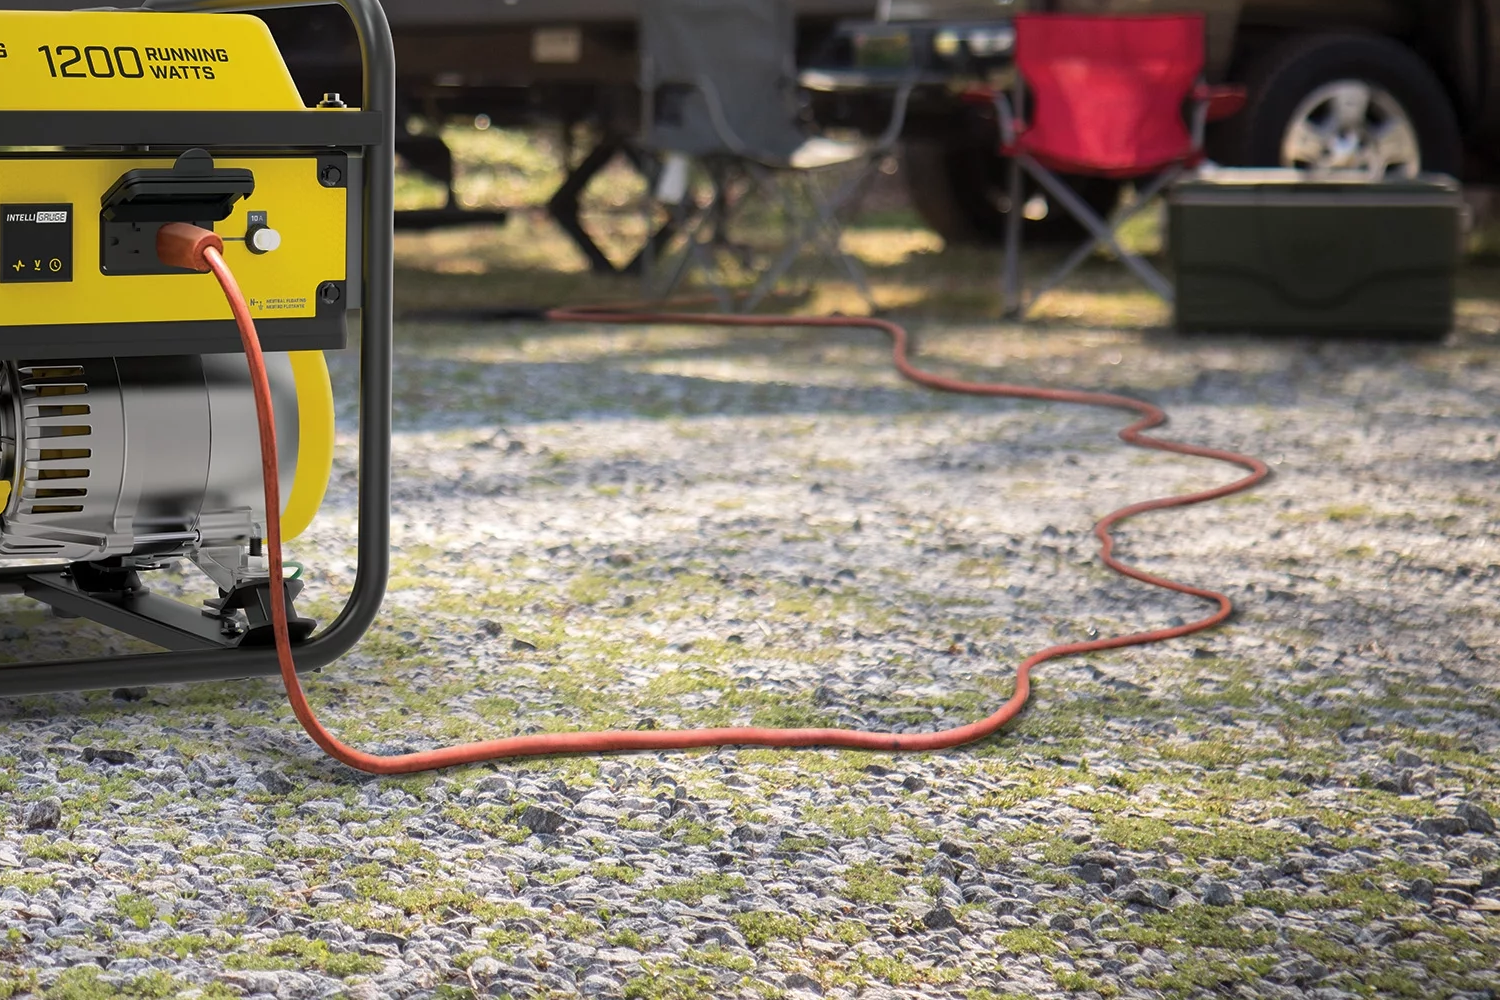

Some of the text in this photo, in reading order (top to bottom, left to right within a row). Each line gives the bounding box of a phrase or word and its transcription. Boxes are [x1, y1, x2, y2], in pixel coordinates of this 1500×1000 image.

[37, 45, 145, 79] 1200
[144, 47, 229, 63] RUNNING
[149, 65, 216, 80] WATTS
